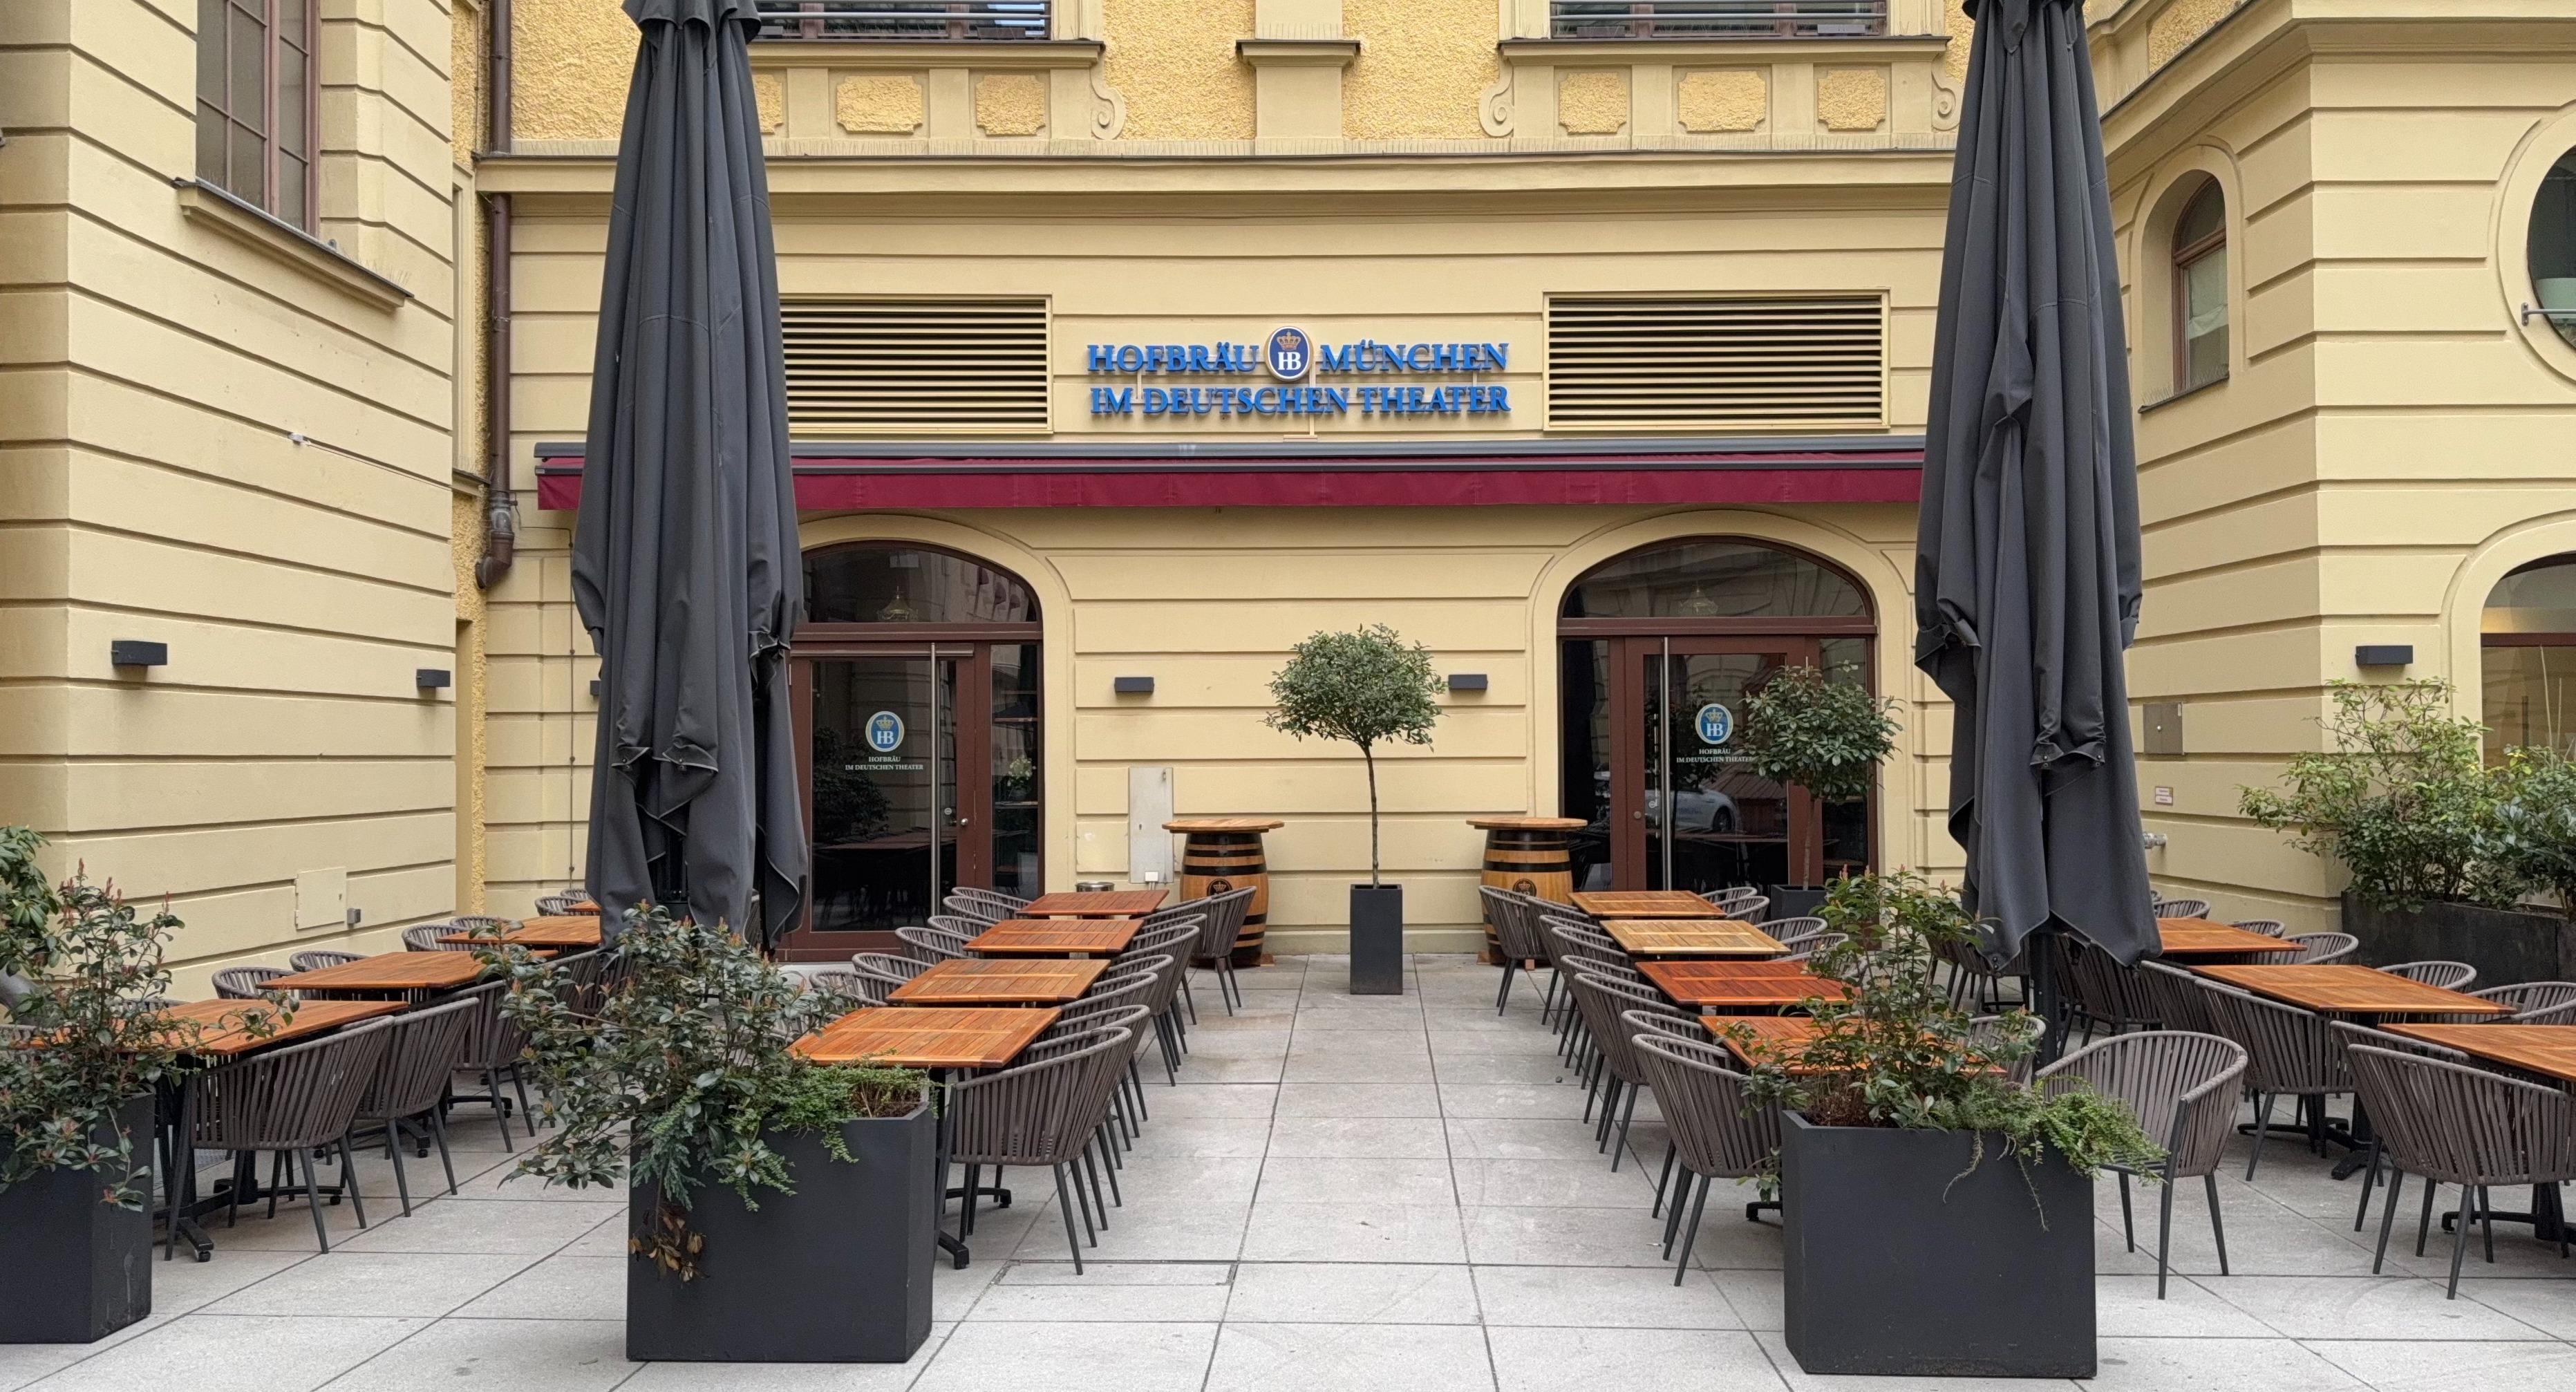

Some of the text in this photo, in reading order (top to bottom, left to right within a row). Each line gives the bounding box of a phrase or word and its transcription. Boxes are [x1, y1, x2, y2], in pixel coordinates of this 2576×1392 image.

[1087, 339, 1509, 372] HOFBRÄU MÜNCHEN
[1277, 351, 1301, 370] HB
[1090, 386, 1511, 414] IM DEUTSCHEN THEATER
[876, 731, 894, 744] HB
[1706, 723, 1724, 737] HB
